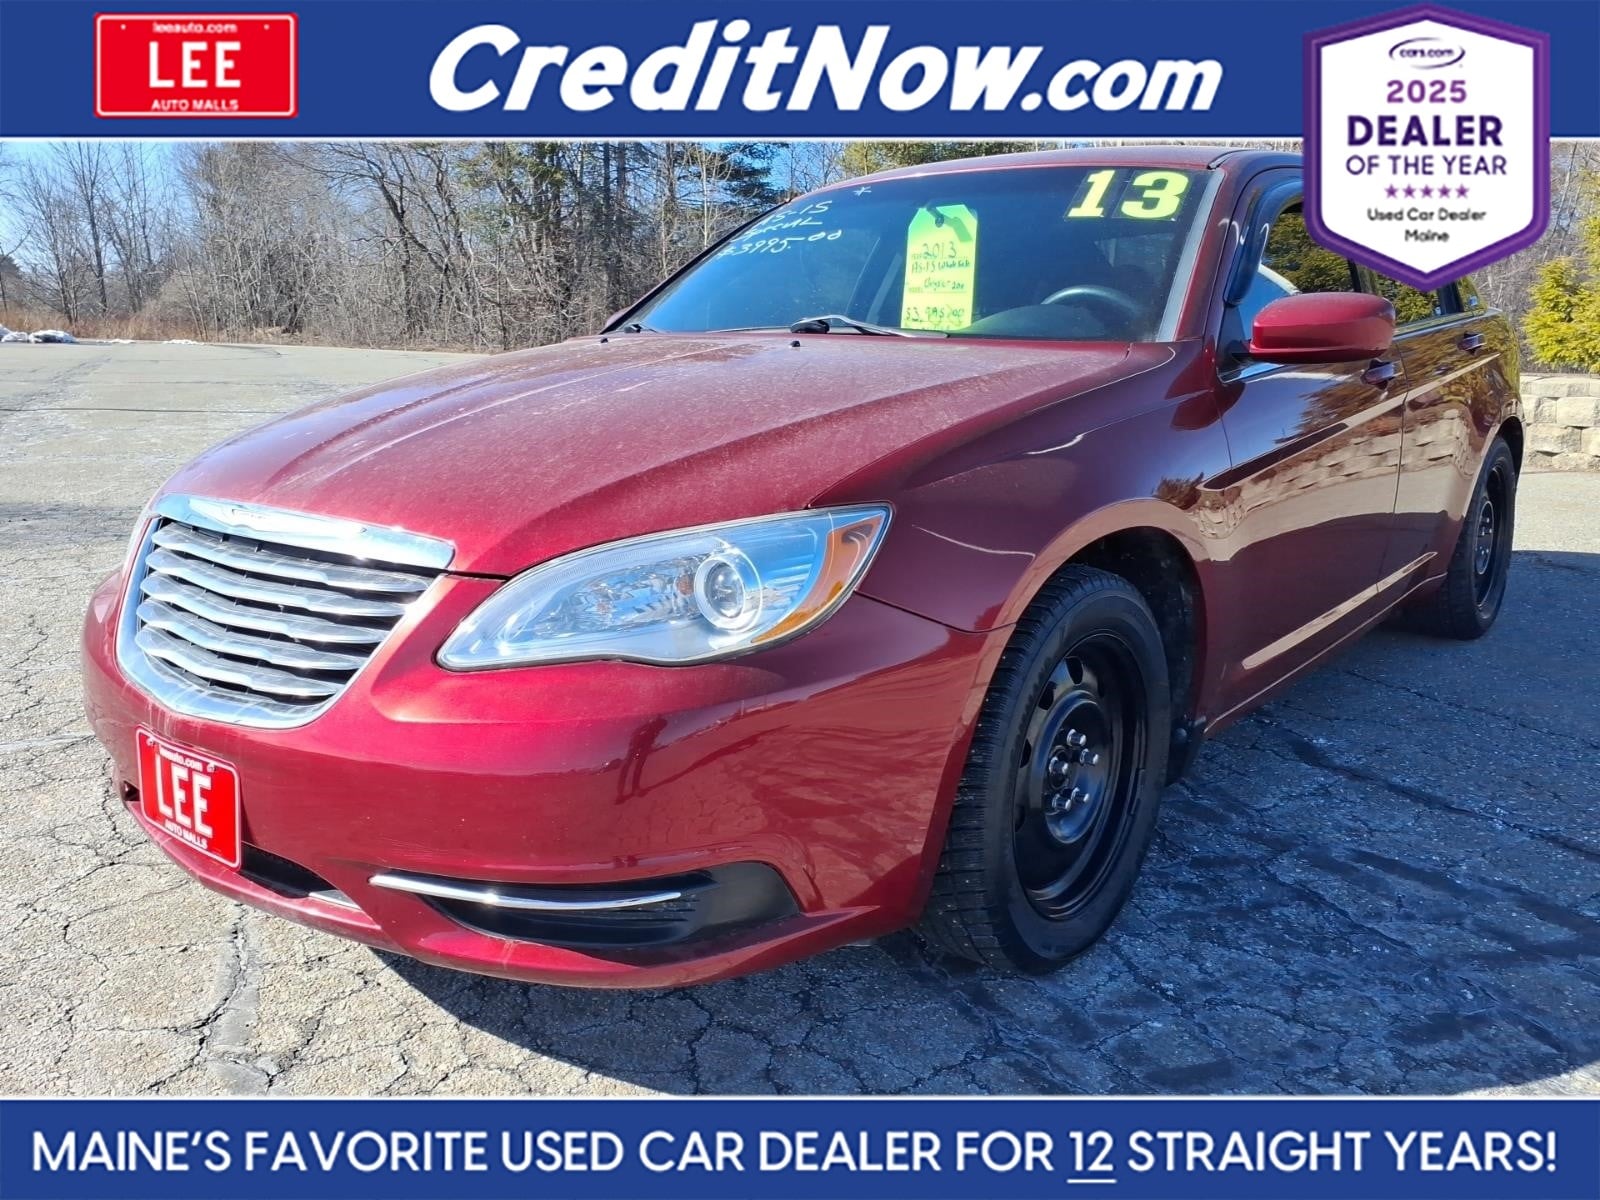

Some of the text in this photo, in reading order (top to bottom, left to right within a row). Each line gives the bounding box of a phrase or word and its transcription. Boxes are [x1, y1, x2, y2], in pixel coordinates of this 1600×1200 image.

[1067, 169, 1189, 219] 13
[922, 241, 957, 259] 2013
[155, 752, 213, 838] LEE
[165, 818, 183, 837] AUTO
